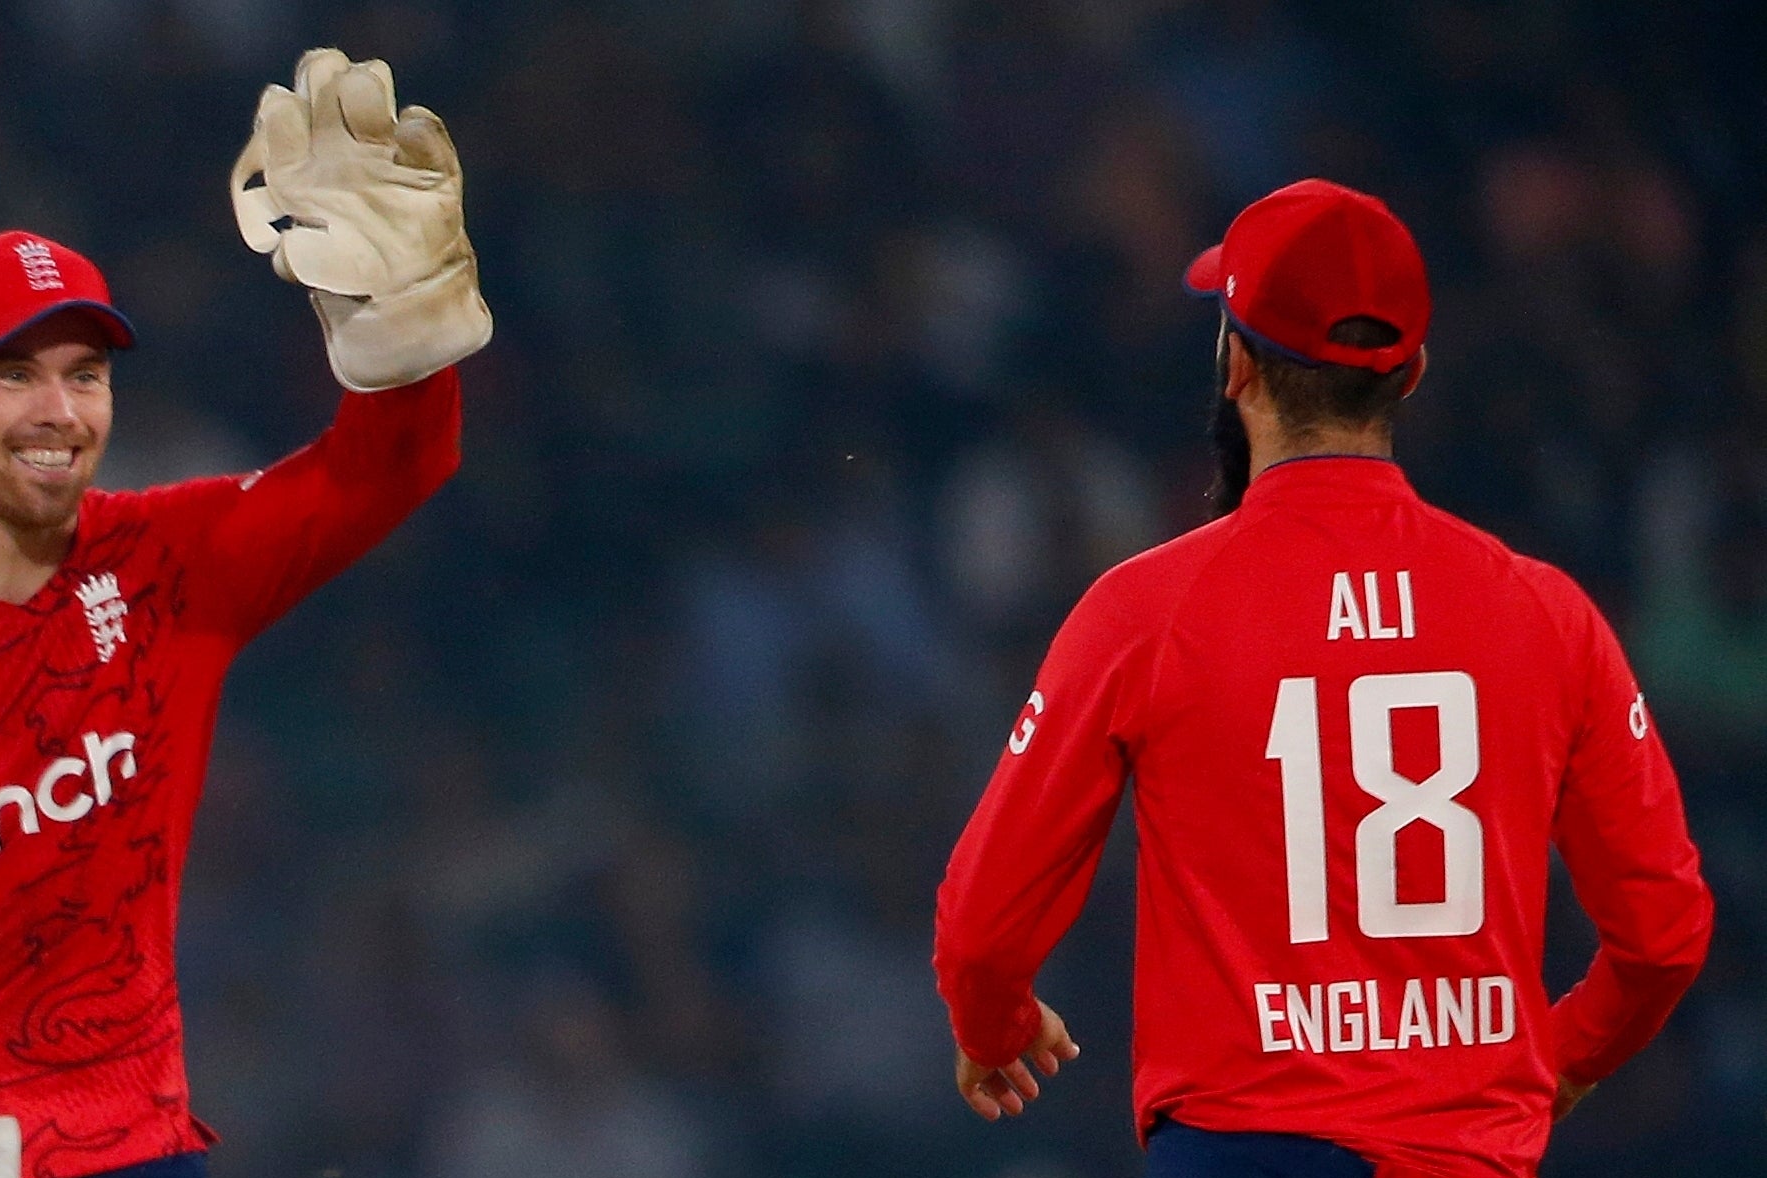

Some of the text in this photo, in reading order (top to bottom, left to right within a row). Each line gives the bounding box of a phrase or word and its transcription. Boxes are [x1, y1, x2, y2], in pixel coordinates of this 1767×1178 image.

[1326, 570, 1416, 640] ALI
[1264, 671, 1484, 944] 18
[1254, 976, 1515, 1053] ENGLAND
